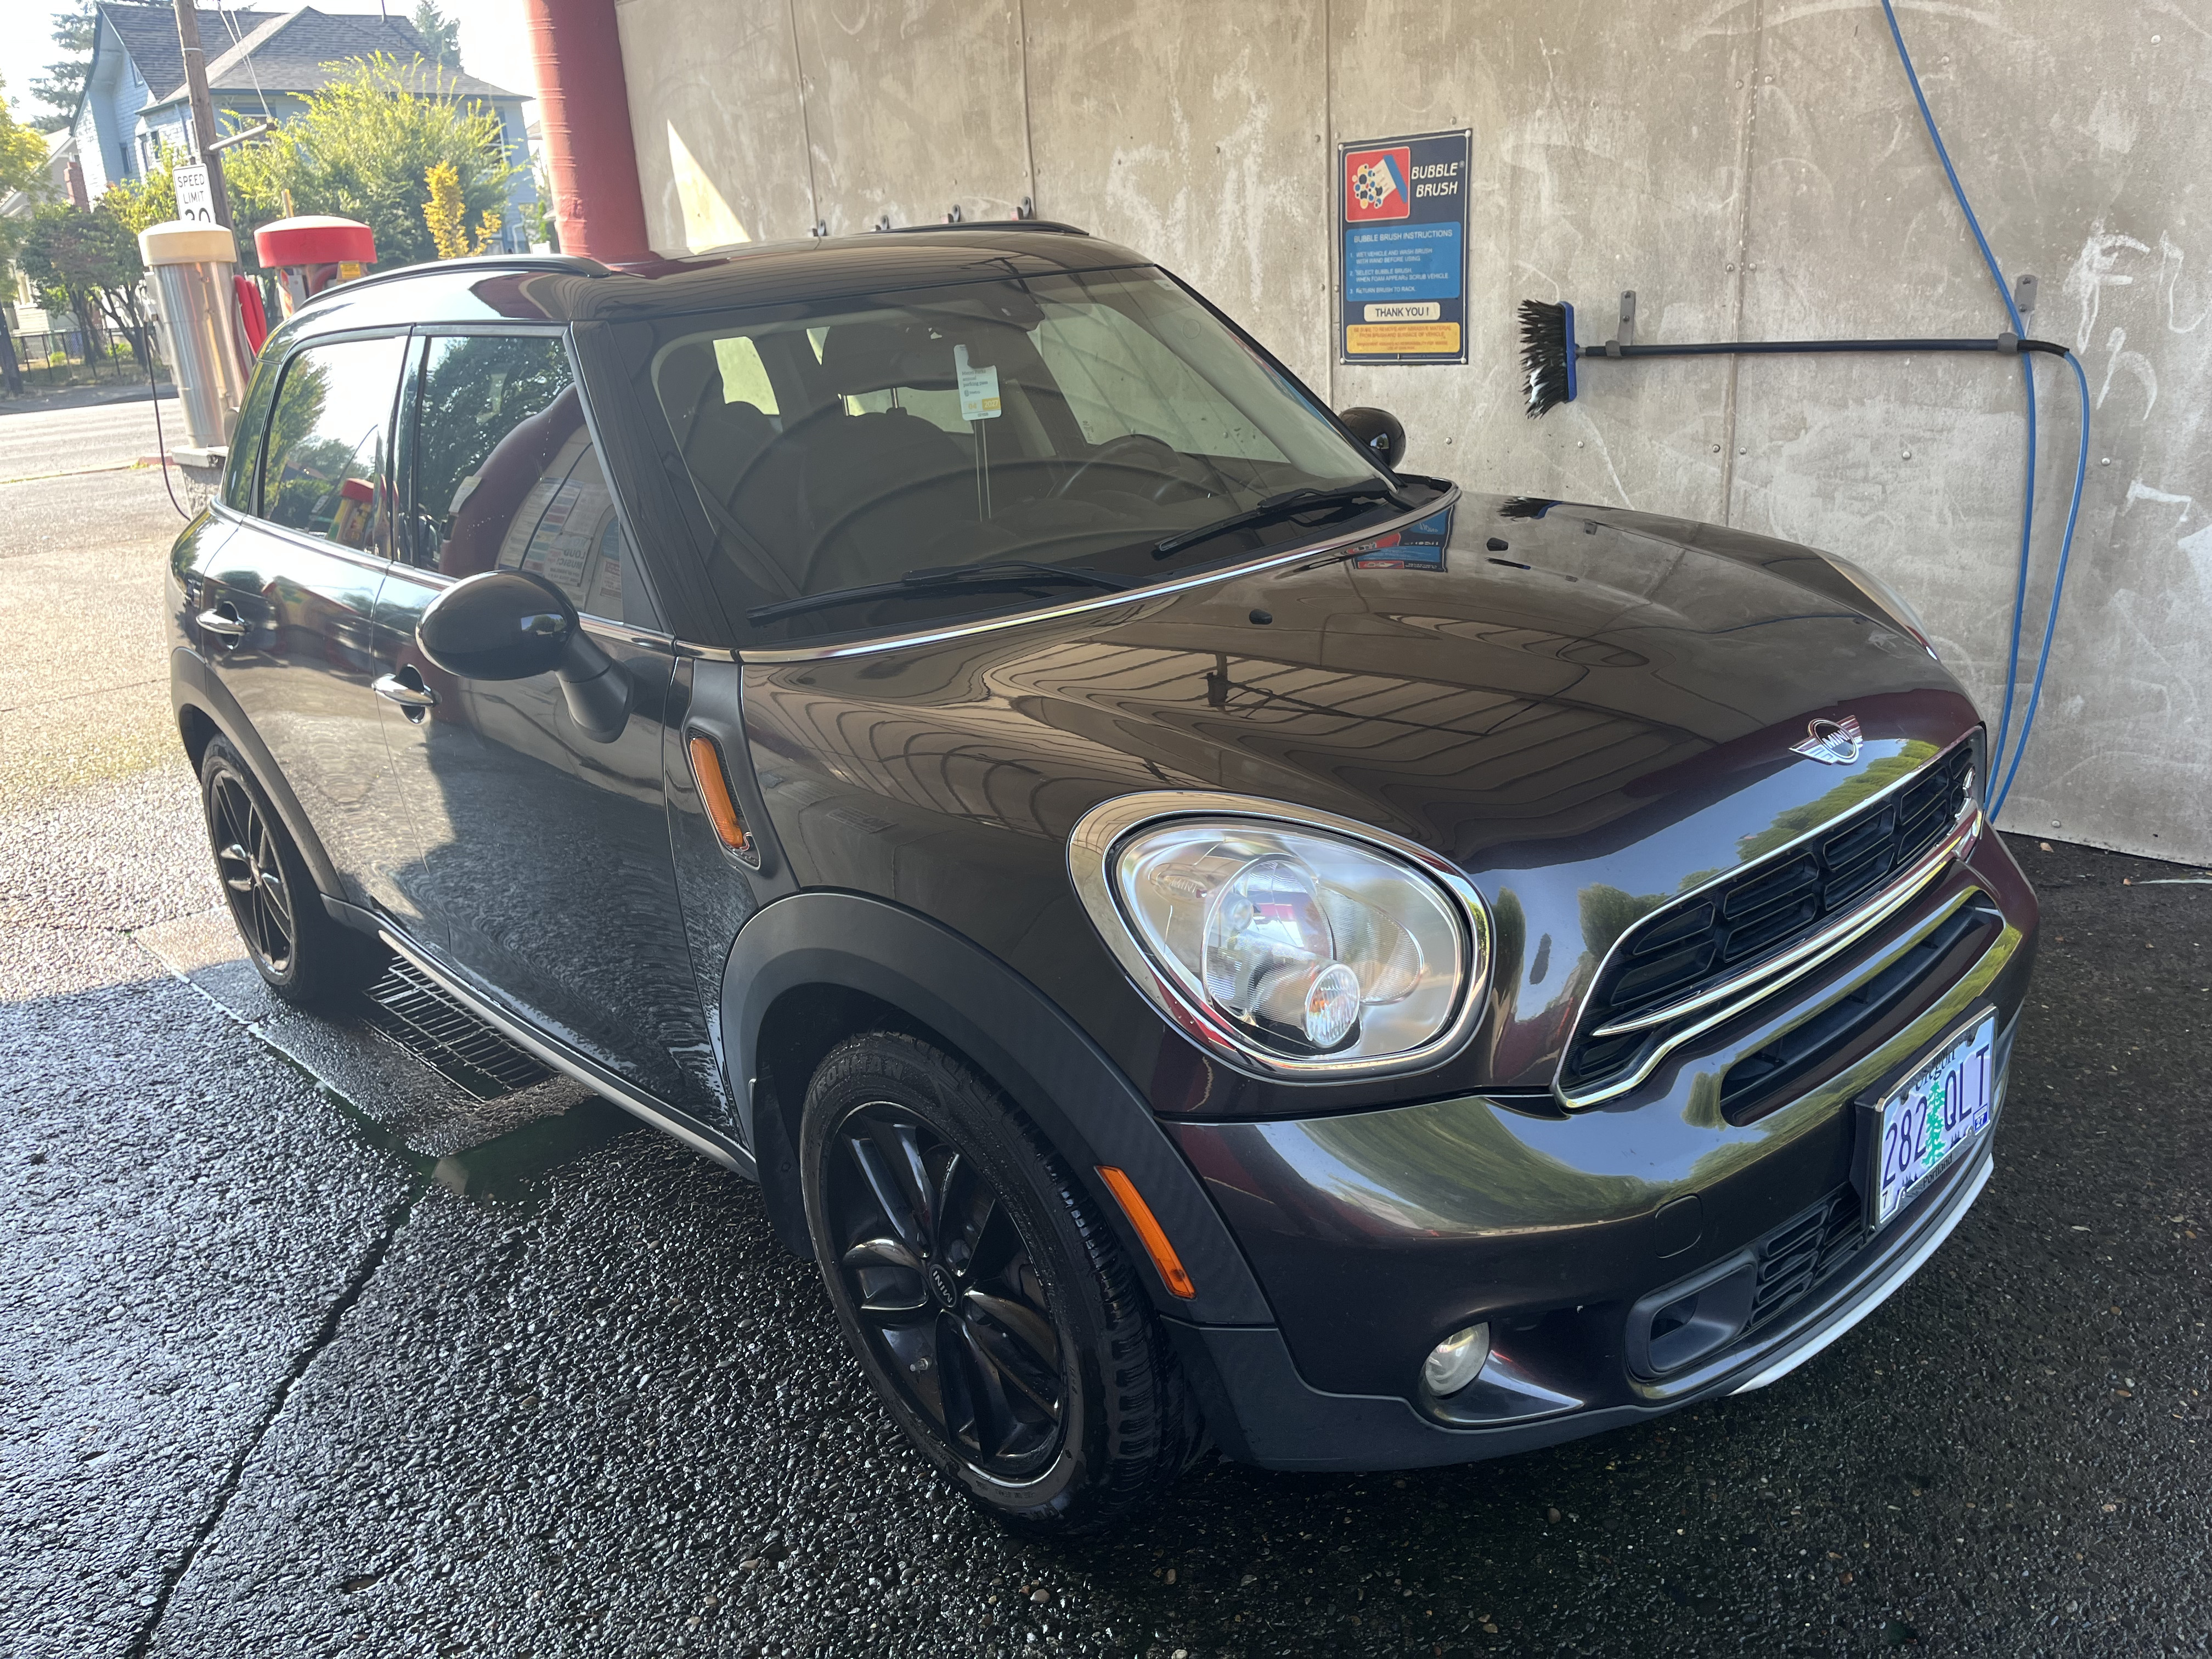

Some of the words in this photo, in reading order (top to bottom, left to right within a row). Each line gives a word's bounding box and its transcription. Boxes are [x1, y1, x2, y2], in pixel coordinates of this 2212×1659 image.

[1411, 162, 1458, 180] BUBBLE
[178, 174, 205, 188] SPEED
[1416, 181, 1458, 198] BRUSH
[183, 190, 204, 204] LIMIT
[1354, 235, 1379, 243] BUBBLE
[1380, 233, 1402, 241] BRUSH
[1403, 229, 1453, 240] INSTRUCTIONS
[1375, 308, 1404, 317] THANK
[1406, 307, 1424, 316] YOU
[984, 399, 998, 408] 2027
[1822, 729, 1850, 749] MINI
[1883, 1096, 1927, 1190] 282
[1944, 1043, 1989, 1131] QLT
[1976, 1114, 1984, 1129] 27
[1923, 1153, 1953, 1188] Portland
[1882, 1190, 1888, 1209] 7
[933, 1270, 953, 1303] MINI
